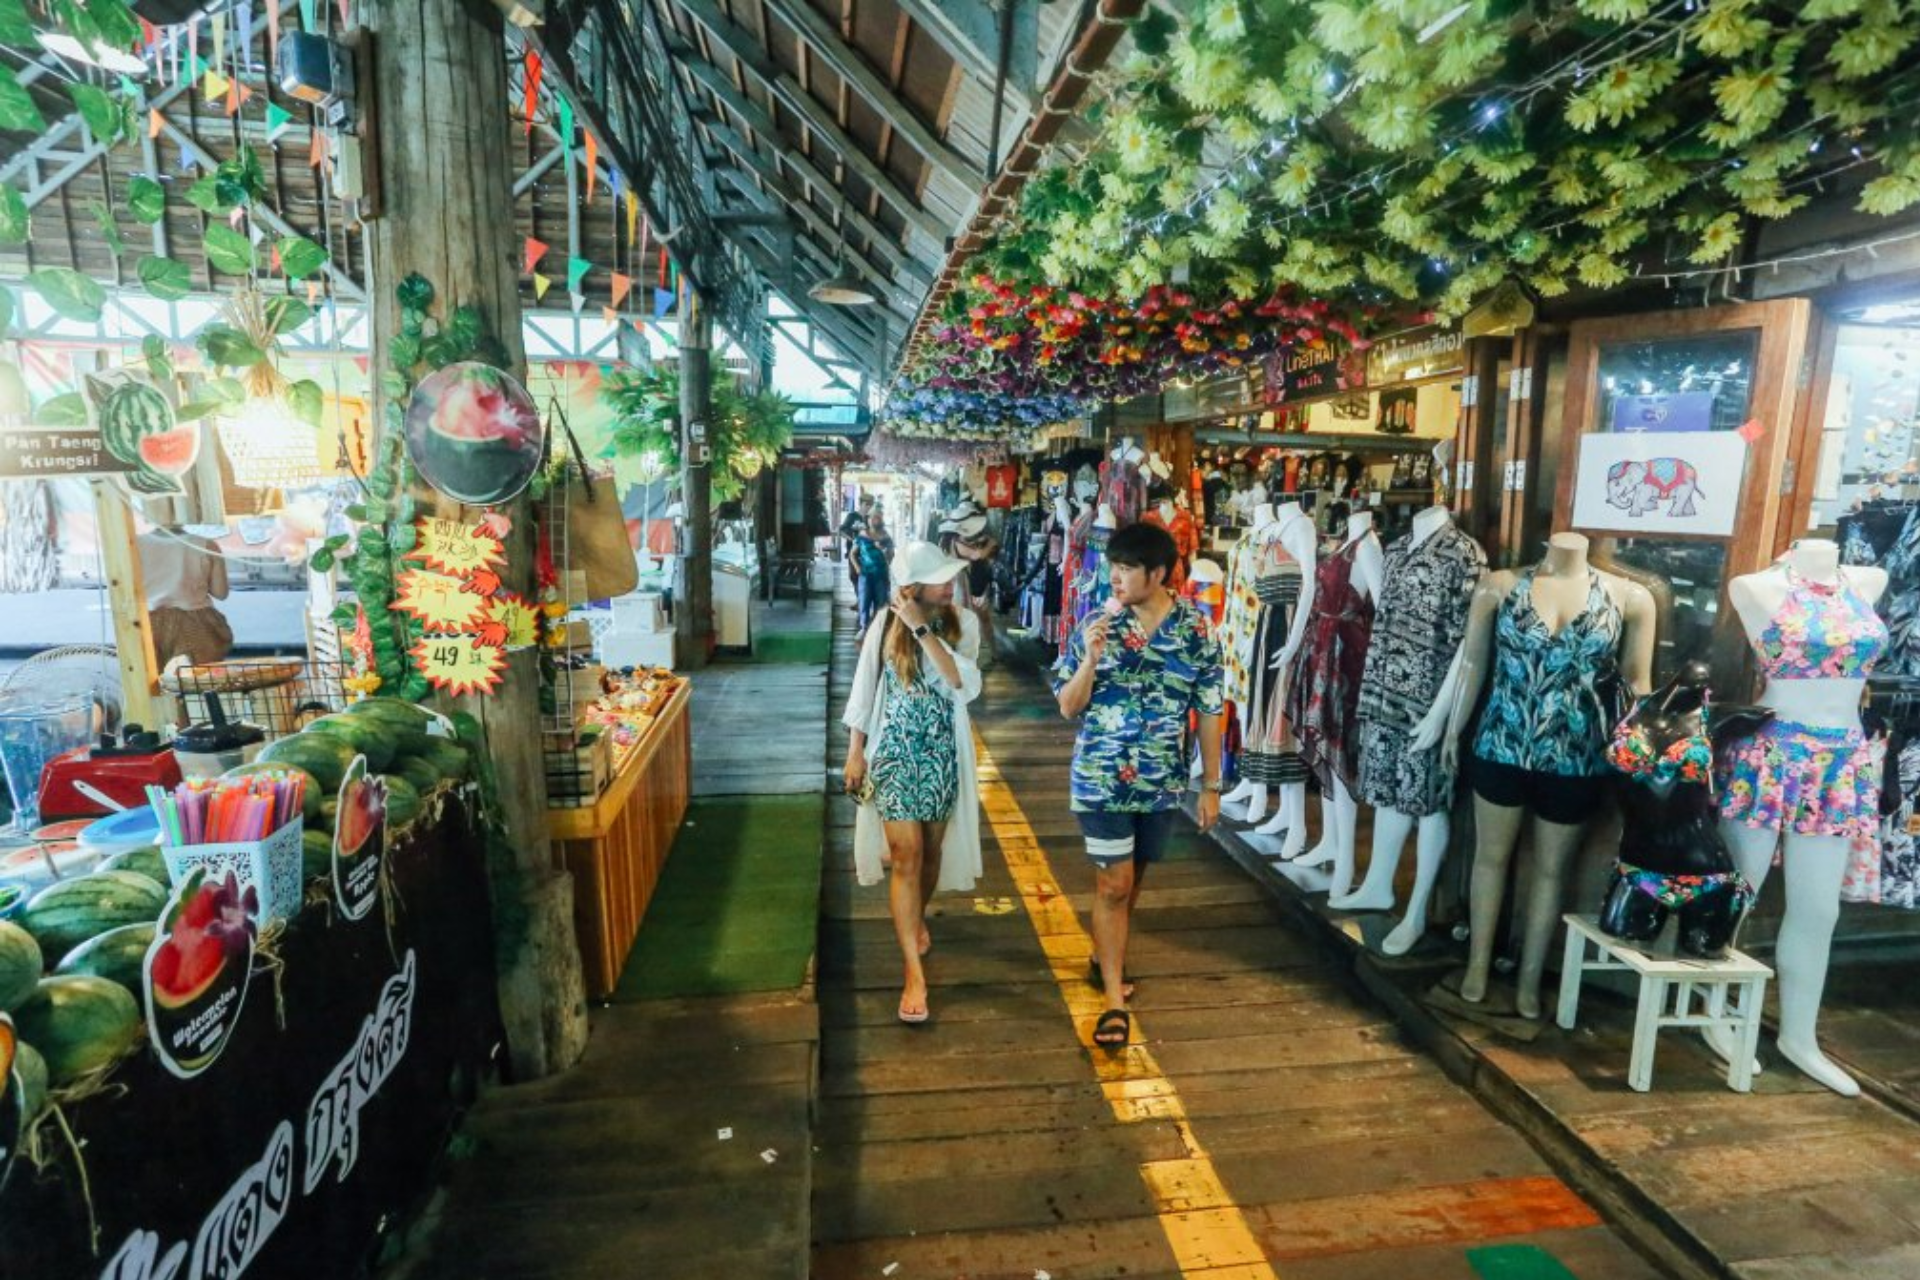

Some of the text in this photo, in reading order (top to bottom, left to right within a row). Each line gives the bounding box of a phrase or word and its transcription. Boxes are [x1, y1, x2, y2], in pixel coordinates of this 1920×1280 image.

[5, 436, 102, 451] Pan Taeng
[20, 454, 99, 470] Krungsri
[432, 646, 459, 667] 49
